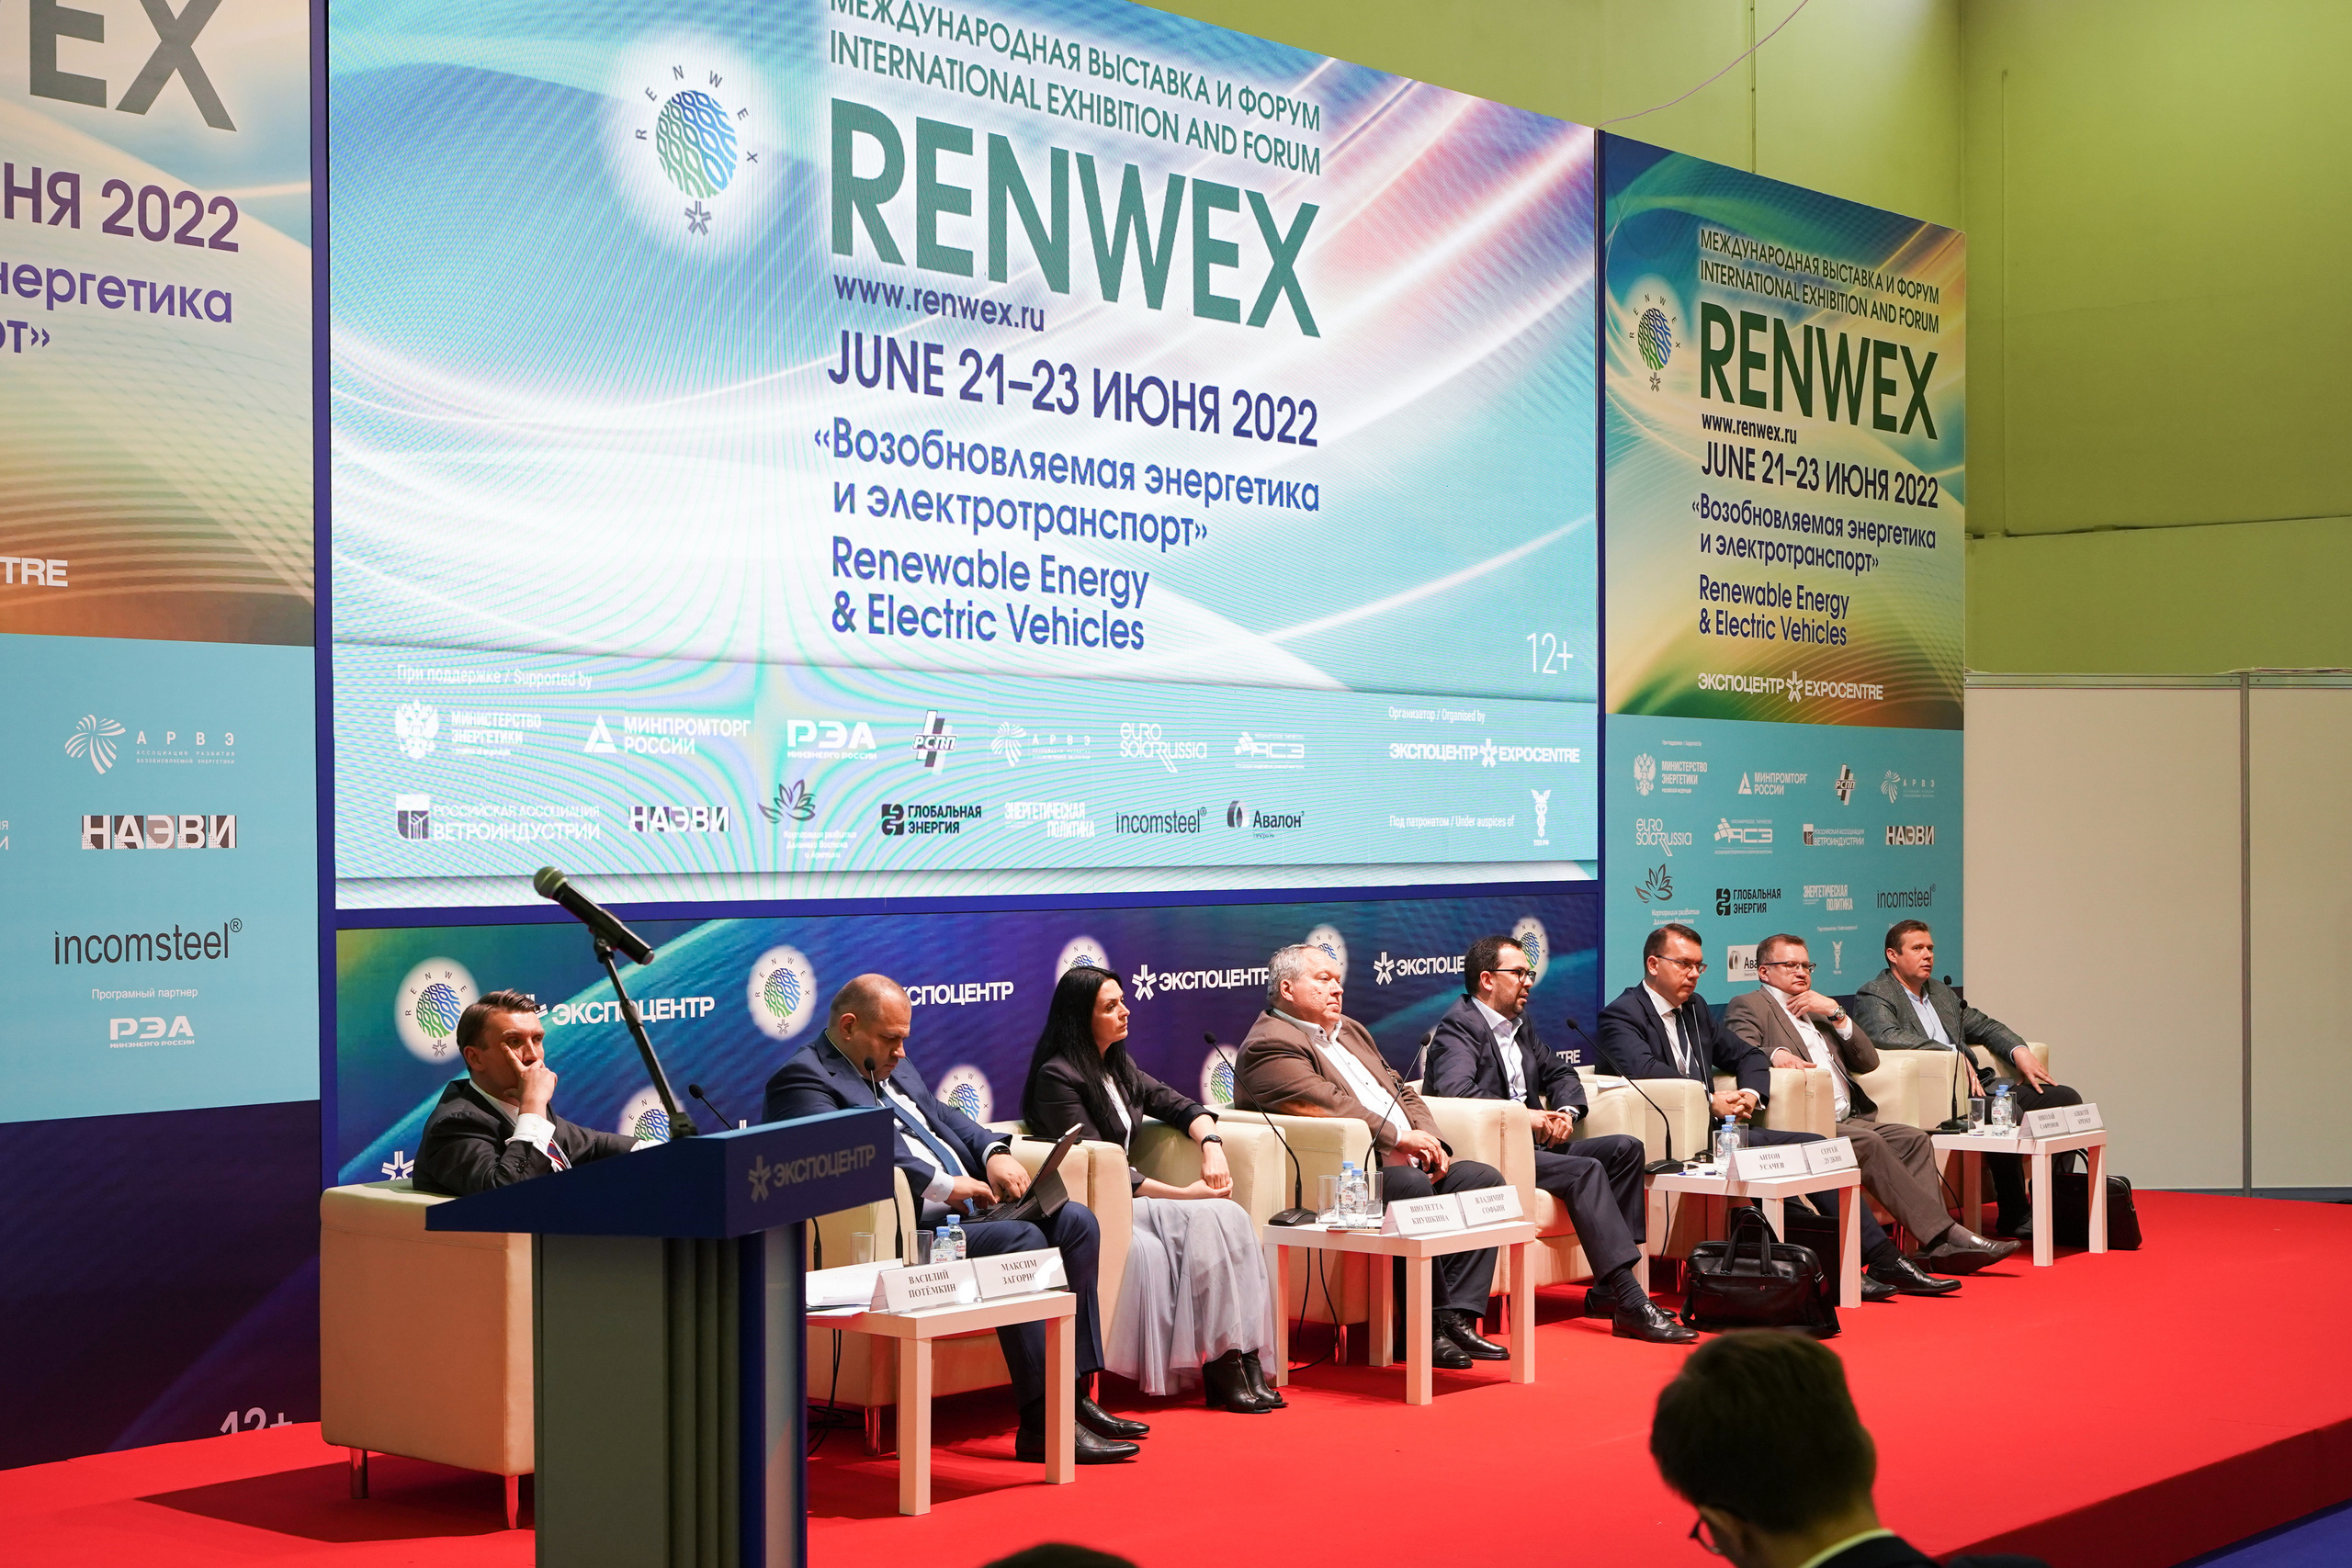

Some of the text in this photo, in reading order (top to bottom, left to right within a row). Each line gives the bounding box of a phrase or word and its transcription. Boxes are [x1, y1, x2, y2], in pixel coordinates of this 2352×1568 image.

[1088, 49, 1210, 105] ВЫСТАВКА
[1217, 81, 1232, 110] И
[1238, 85, 1320, 132] ФОРУМ
[831, 29, 1320, 176] INTERNATIONAL EXHIBITION AND FORUM
[101, 178, 239, 253] 2022
[831, 96, 1321, 338] RENWEX
[1701, 229, 1939, 305] МЕЖДУНАРОДНАЯ ВЫСТАВКА И ФОРУМ
[834, 274, 1045, 332] www.renwex.ru
[1701, 260, 1939, 333] INTERNATIONAL EXHIBITION AND FORUM
[1701, 301, 1939, 440] RENWEX
[828, 329, 944, 397] JUNE
[1093, 367, 1219, 434] ИЮНЯ
[1232, 389, 1317, 448] 2022
[1702, 413, 1797, 445] www.renwex.ru
[814, 416, 1320, 512] «Возобновляемая энергетика
[1702, 441, 1756, 481] JUNE
[1826, 460, 1888, 502] ИЮНЯ
[1894, 471, 1939, 509] 2022
[833, 482, 1207, 553] и электротранспорт»
[1691, 492, 1936, 549] «Возобновляемая энергетика
[1701, 533, 1879, 577] и электротранспорт»
[832, 535, 1149, 609] Renewable Energy
[1700, 574, 1849, 620] Renewable Energy
[831, 590, 1145, 650] & Electric Vehicles
[1699, 607, 1847, 646] & Electric Vehicles
[1526, 632, 1574, 674] 12+
[397, 664, 424, 683] При
[427, 667, 501, 685] поддержке
[514, 668, 575, 689] Supported
[579, 671, 593, 691] by
[1698, 672, 1883, 701] ЭКСПОЦЕНТР EXPOCENTRE
[451, 712, 542, 728] МИНИСТЕРСТВО
[1389, 706, 1435, 723] Организатор
[1442, 708, 1476, 724] Organised
[1477, 710, 1486, 725] by
[624, 716, 751, 738] МИНПРОМТОРГ
[786, 719, 876, 750] РЭА
[624, 736, 695, 756] РОССИИ
[912, 734, 957, 751] РСПП
[1389, 742, 1580, 762] ЭКСПОЦЕНТР EXPOCENTRE
[1661, 761, 1708, 773] МИНИСТЕРСТВО
[1661, 773, 1698, 784] ЭНЕРГЕТИКИ
[1754, 772, 1807, 784] МИНПРОМТОРГ
[1835, 780, 1856, 790] РСПП
[1754, 784, 1784, 795] РОССИИ
[433, 802, 600, 818] РОССИЙСКАЯ АССОЦИАЦИЯ
[628, 807, 730, 832] НАЭВИ
[908, 805, 982, 819] ГЛОБАЛЬНАЯ
[1004, 801, 1086, 820] ЭНЕРГЕТИЧЕСКАЯ
[434, 822, 600, 843] ВЕТРОИНДУСТРИИ
[908, 820, 960, 834] ЭНЕРГИЯ
[1046, 820, 1095, 838] ПОЛИТИКА
[1389, 815, 1405, 829] Под
[1407, 817, 1449, 829] патронатом
[1455, 815, 1476, 828] Under
[1477, 817, 1506, 829] auspices
[1507, 815, 1515, 828] of
[82, 815, 237, 851] НАЭВИ
[1814, 837, 1864, 847] ВЕТРОИНДУСТРИИ
[1885, 826, 1935, 845] НАЭВИ
[1733, 888, 1781, 900] ГЛОБАЛЬНАЯ
[1804, 885, 1848, 898] ЭНЕРГЕТИЧЕСКАЯ
[1733, 902, 1767, 914] ЭНЕРГИЯ
[1826, 897, 1853, 910] ПОЛИТИКА
[1396, 955, 1465, 976] ЭКСПОЦЕ
[92, 985, 198, 1000] Програмный партнер
[903, 981, 1014, 1007] СПОЦЕНТР
[109, 1015, 195, 1041] РЭА
[109, 1039, 195, 1049] МИНЭНЕРГО РОССИИ
[774, 1145, 876, 1188] ЭКСПОЦЕНТР
[1759, 1162, 1785, 1171] УСАЧЕВ
[1409, 1202, 1443, 1213] ВИОЛЕТТА
[1475, 1193, 1505, 1204] ВЛАДИМИР
[1001, 1259, 1037, 1272] МАКСИМ
[908, 1269, 950, 1285] ВАСИЛИЙ
[908, 1282, 956, 1300] ПОТЁМКИН
